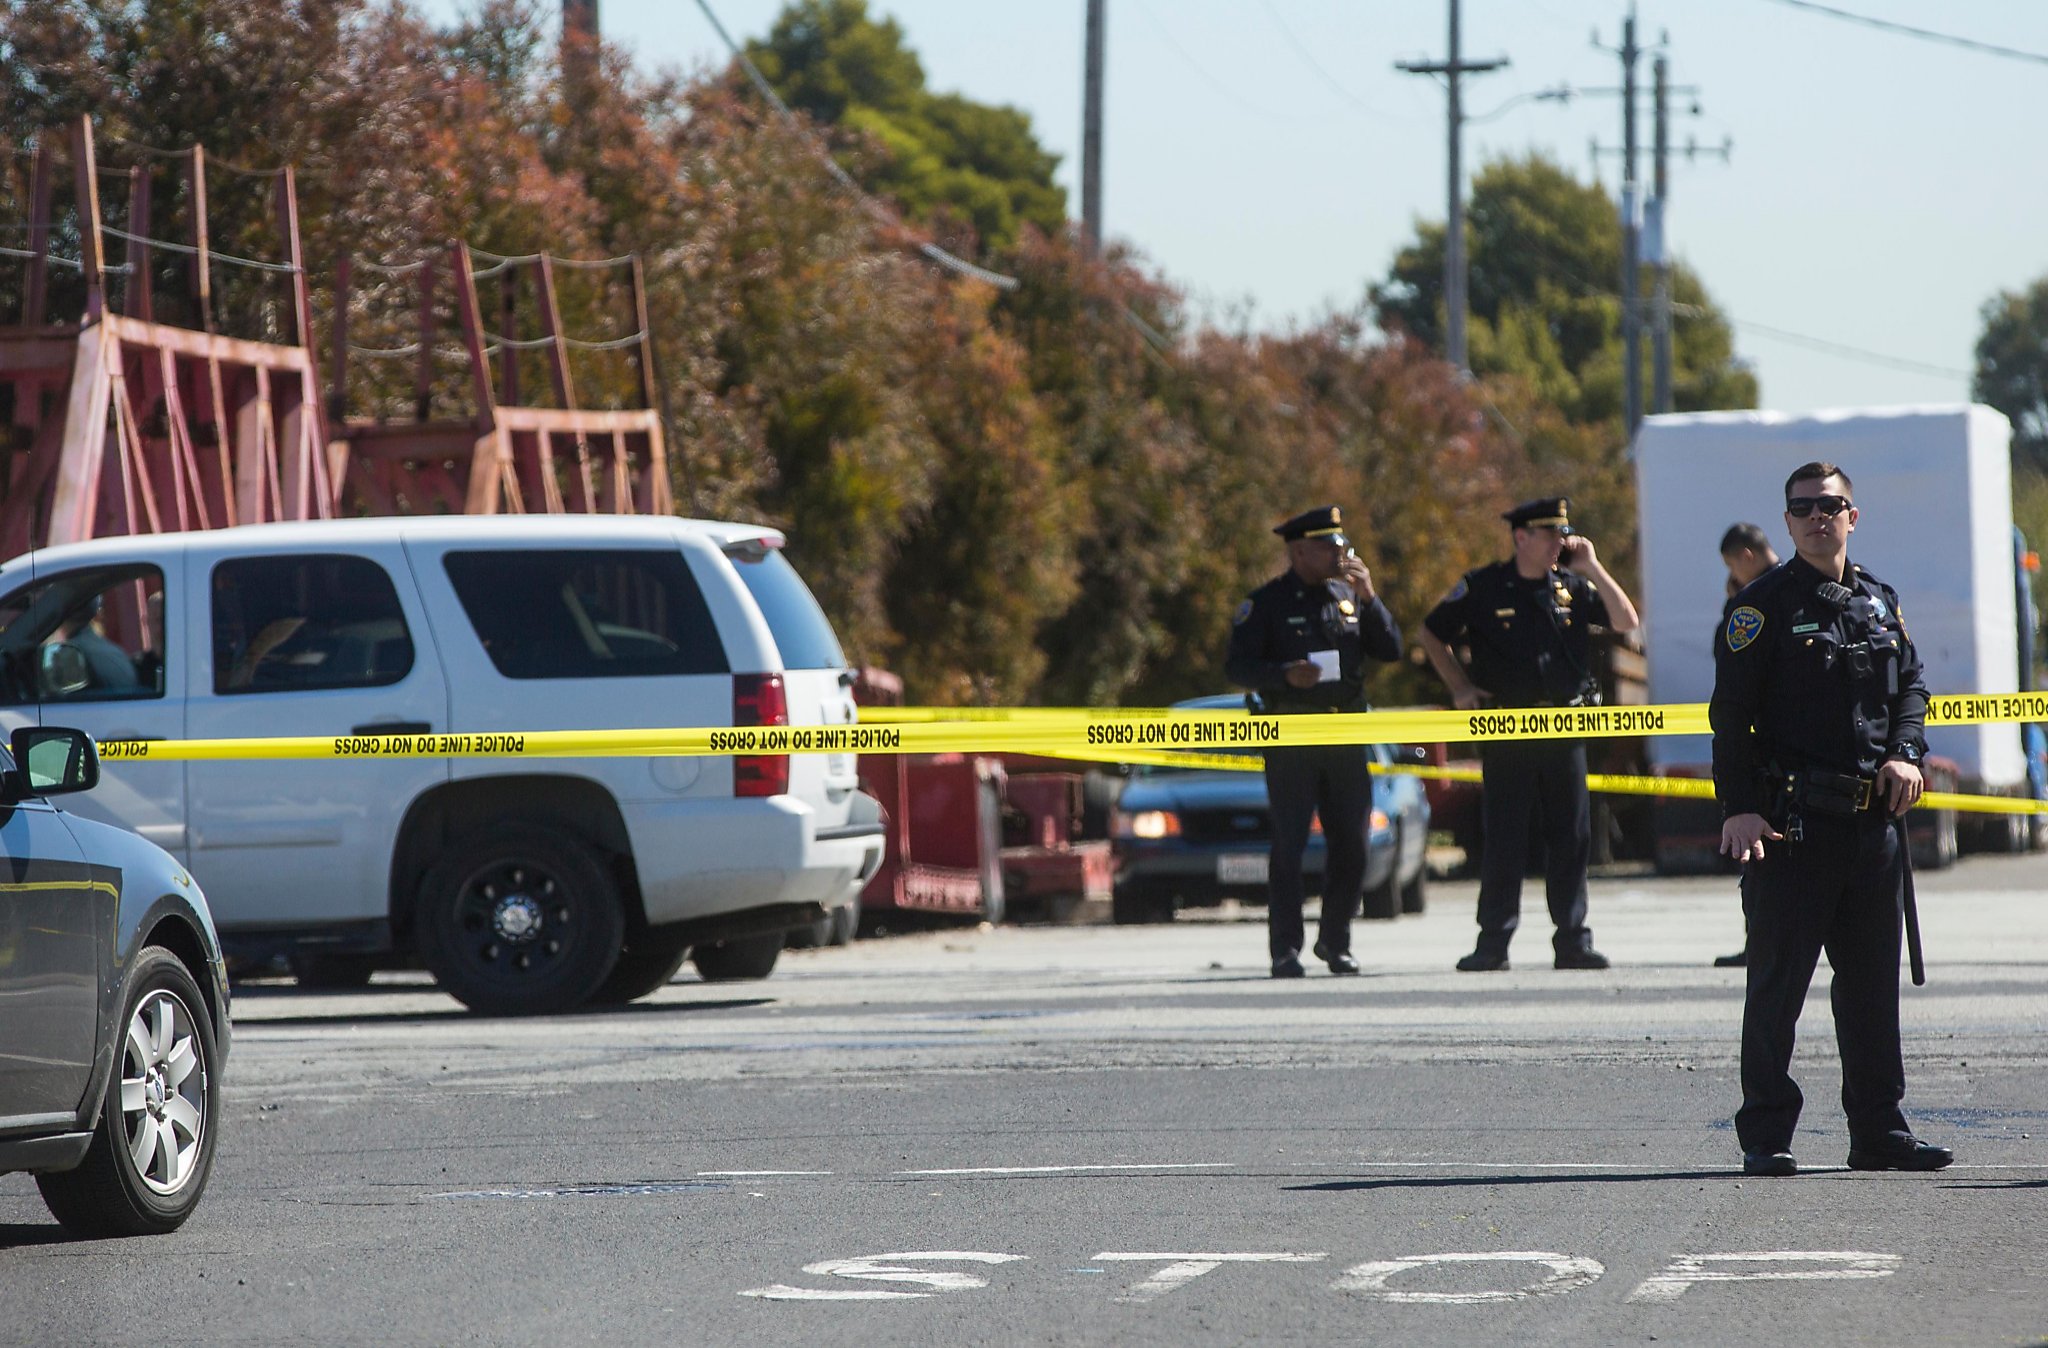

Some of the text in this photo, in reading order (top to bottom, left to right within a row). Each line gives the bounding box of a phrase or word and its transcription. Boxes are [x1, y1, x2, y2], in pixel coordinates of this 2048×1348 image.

[1942, 701, 1962, 719] DO
[1967, 700, 1998, 718] LINE
[1087, 721, 1279, 744] POLICE LINE DO NOT CROSS
[1469, 711, 1664, 735] POLICE LINE DO NOT CROSS
[334, 736, 524, 754] POLICE LINE DO NOT CROSS
[710, 729, 900, 750] POLICE LINE DO NOT CROSS
[99, 743, 148, 756] POLICE
[737, 1250, 1902, 1303] STOP
